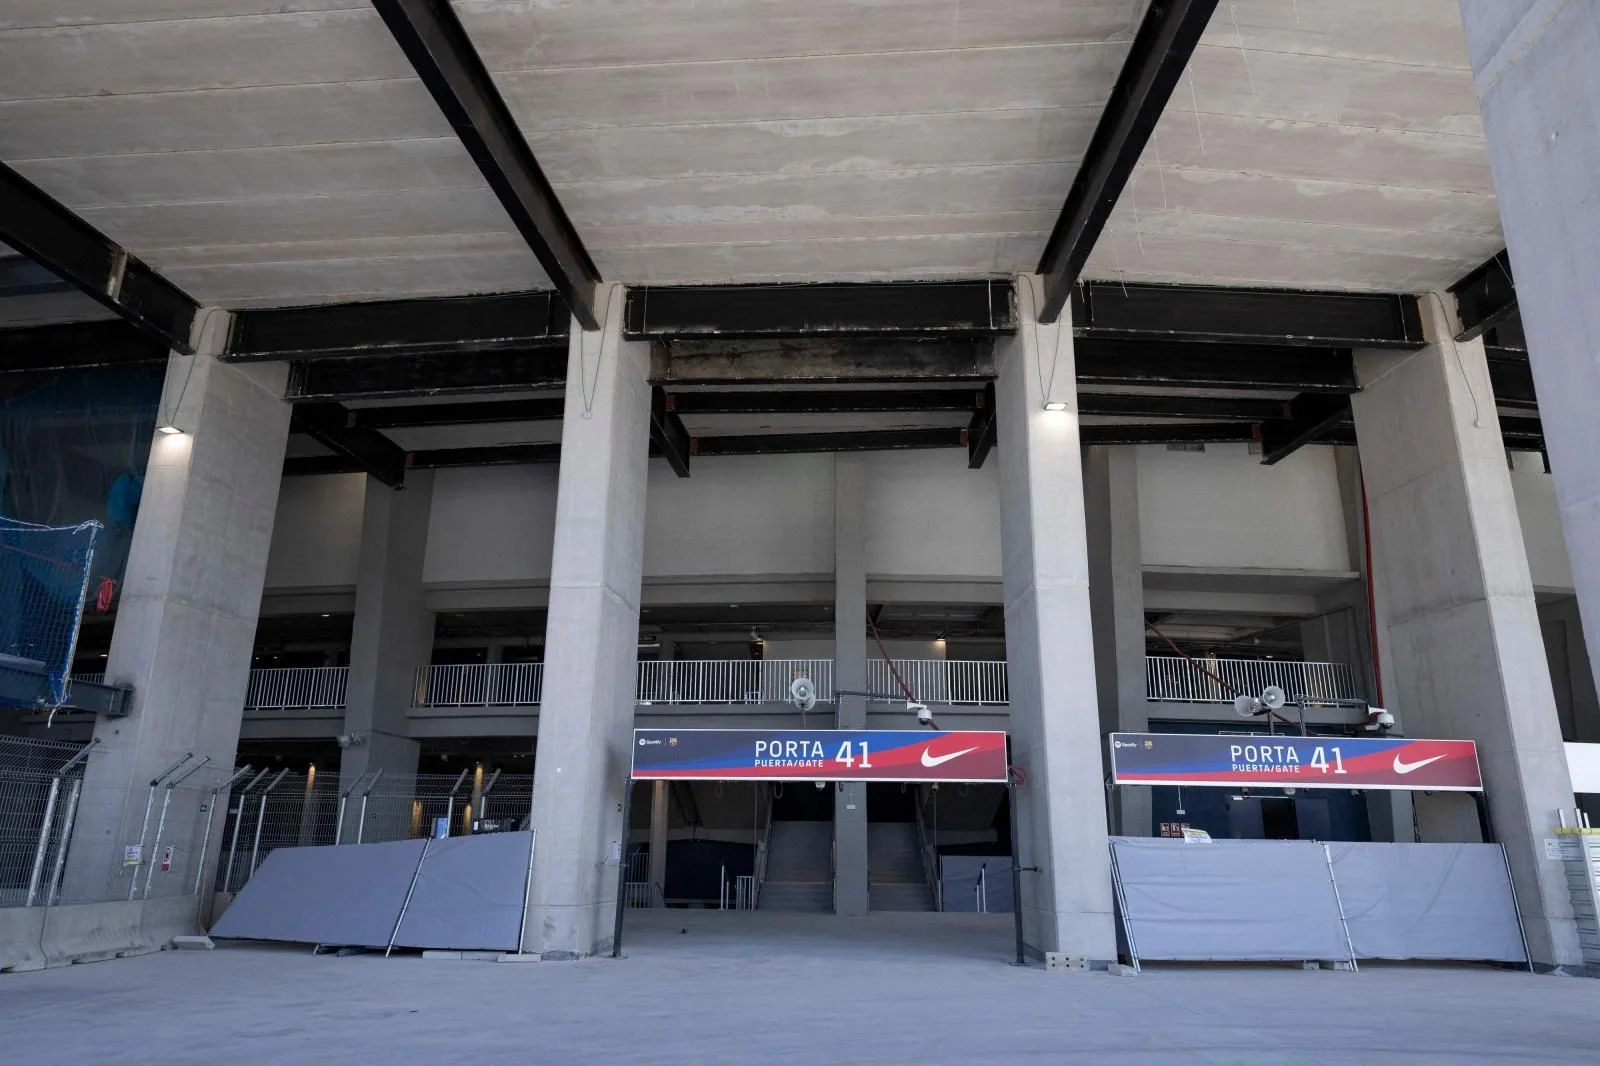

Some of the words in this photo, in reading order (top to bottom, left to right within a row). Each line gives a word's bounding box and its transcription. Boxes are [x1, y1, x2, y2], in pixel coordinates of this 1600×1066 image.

[754, 759, 824, 767] PUERTA/GATE
[755, 740, 824, 758] PORTA
[835, 740, 872, 768] 41
[1230, 745, 1299, 763] PORTA
[1310, 746, 1347, 774] 41
[1232, 763, 1300, 773] PUERTA/GATE
